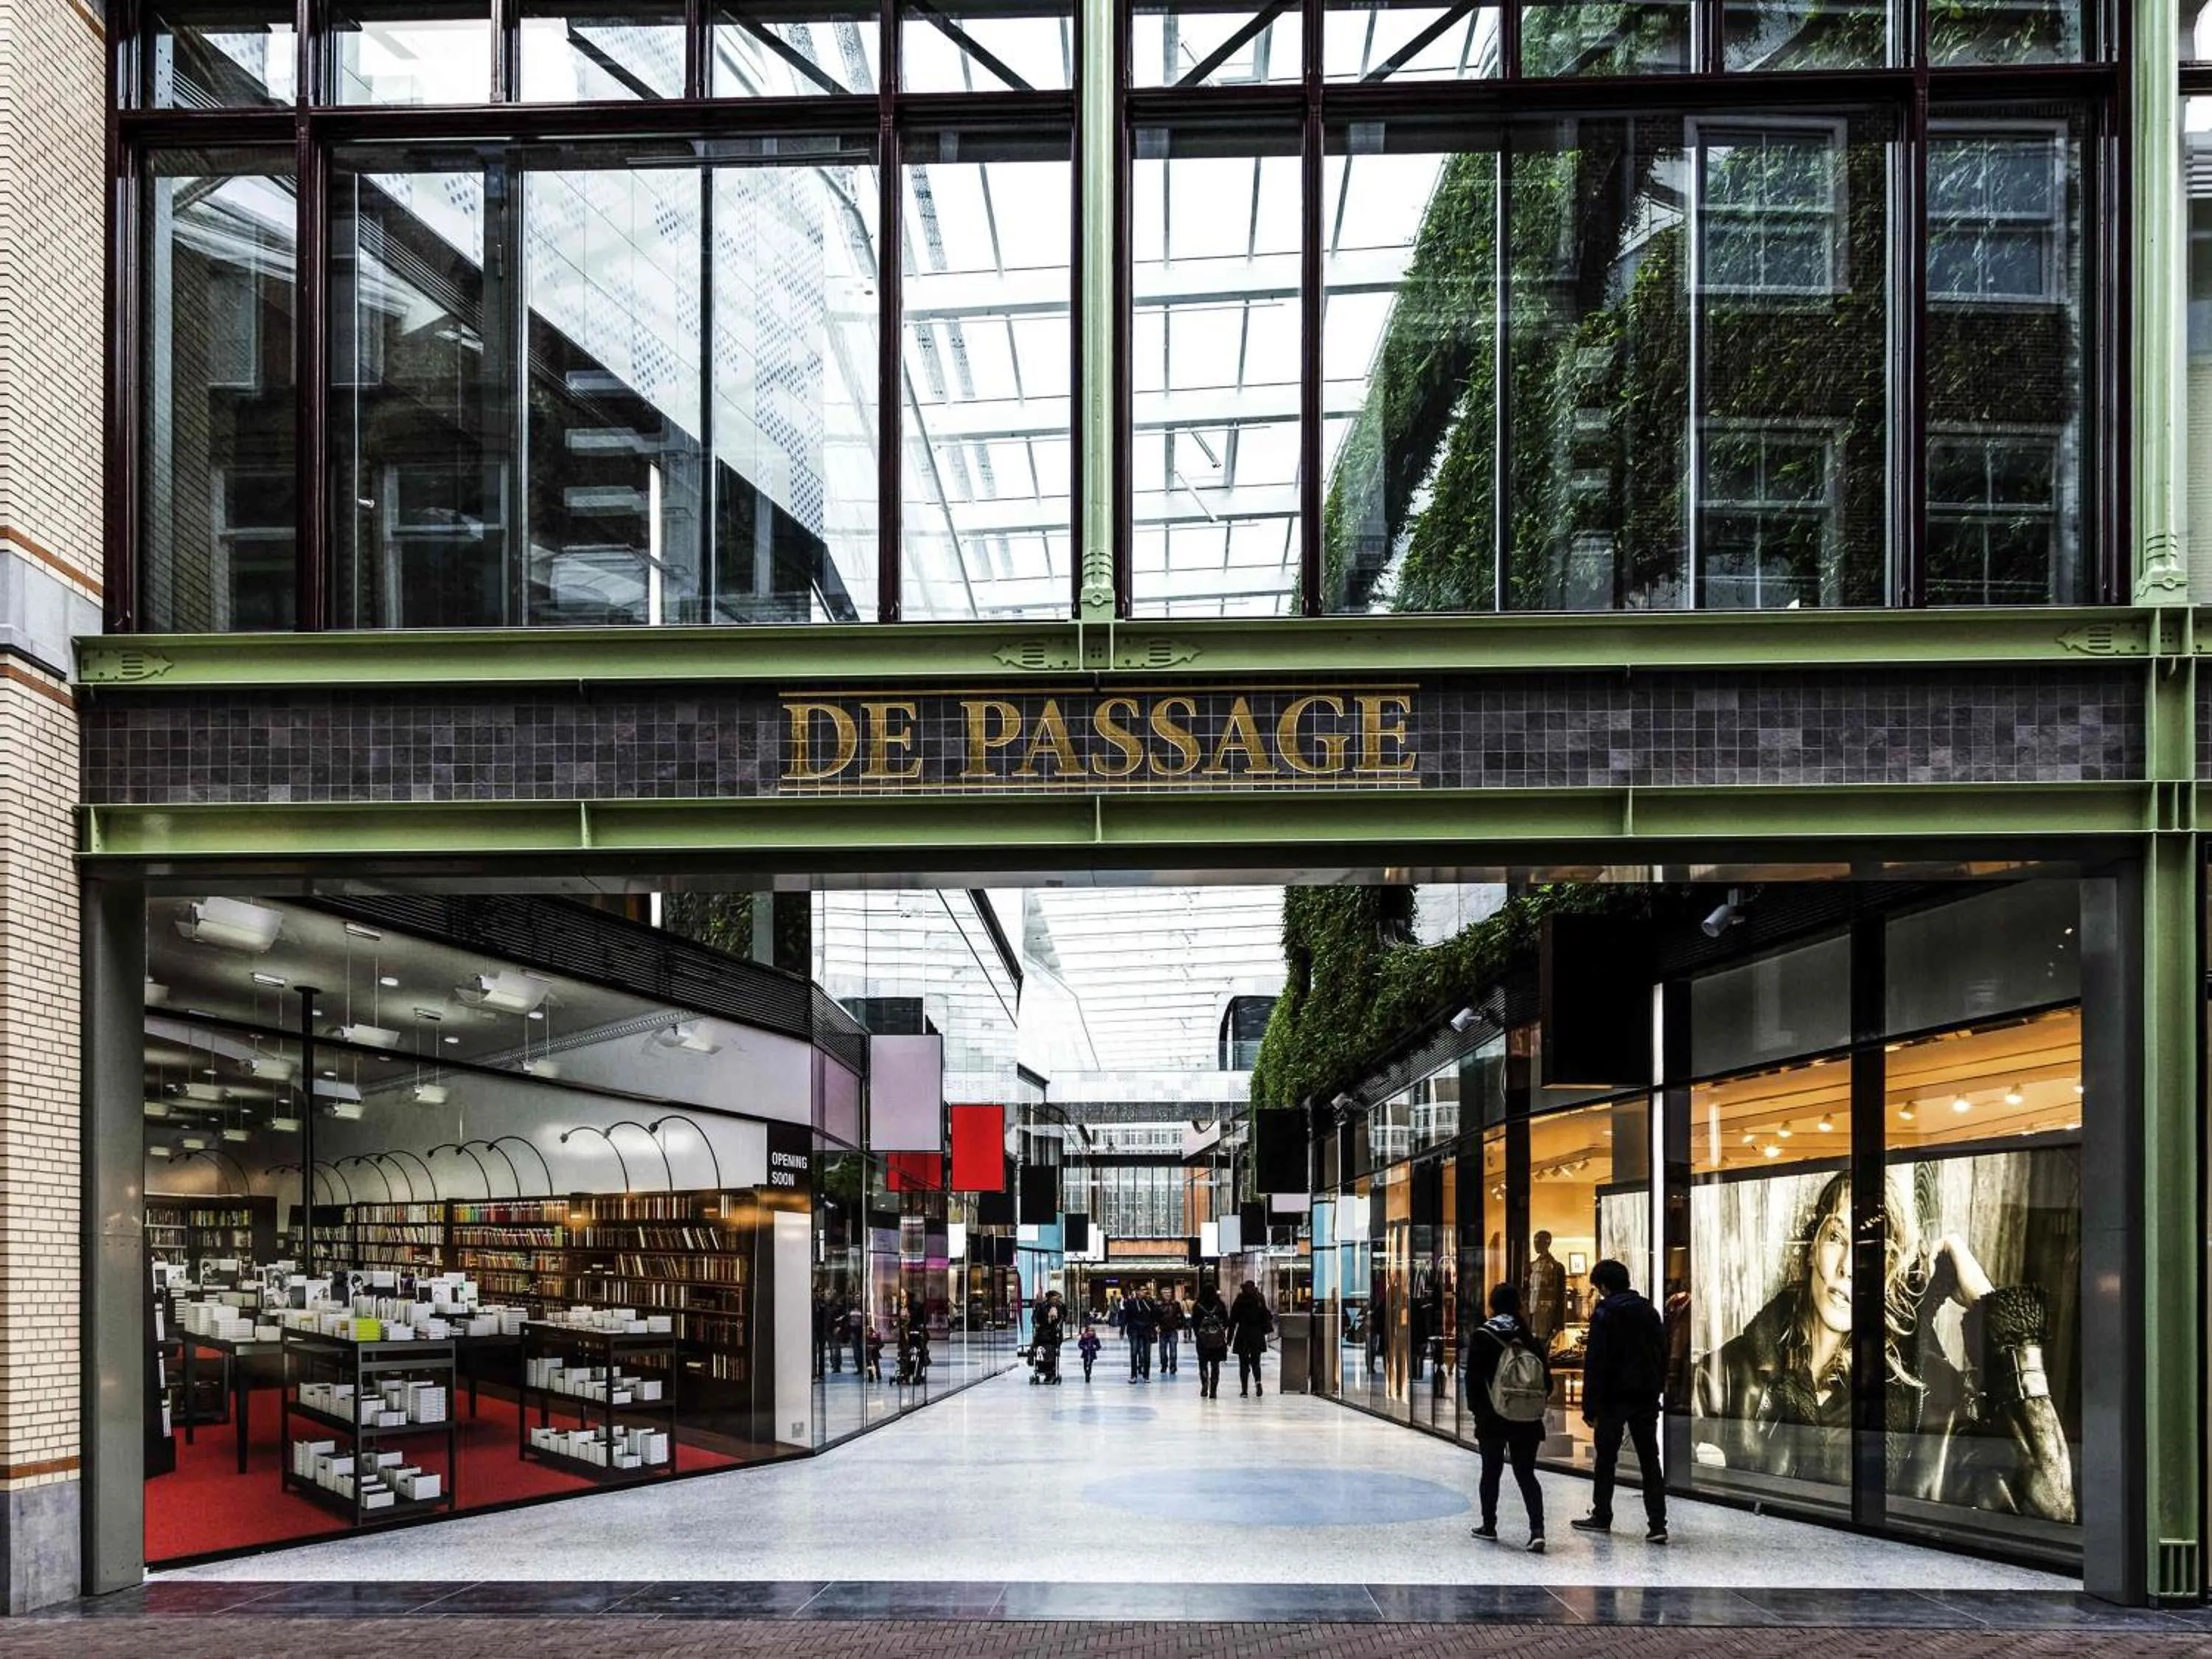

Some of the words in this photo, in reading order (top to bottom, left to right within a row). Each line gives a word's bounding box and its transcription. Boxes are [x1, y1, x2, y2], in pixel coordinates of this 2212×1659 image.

[781, 703, 922, 779] DE
[960, 695, 1416, 776] PASSAGE
[772, 1152, 807, 1169] OPENING
[772, 1172, 794, 1186] SOON
